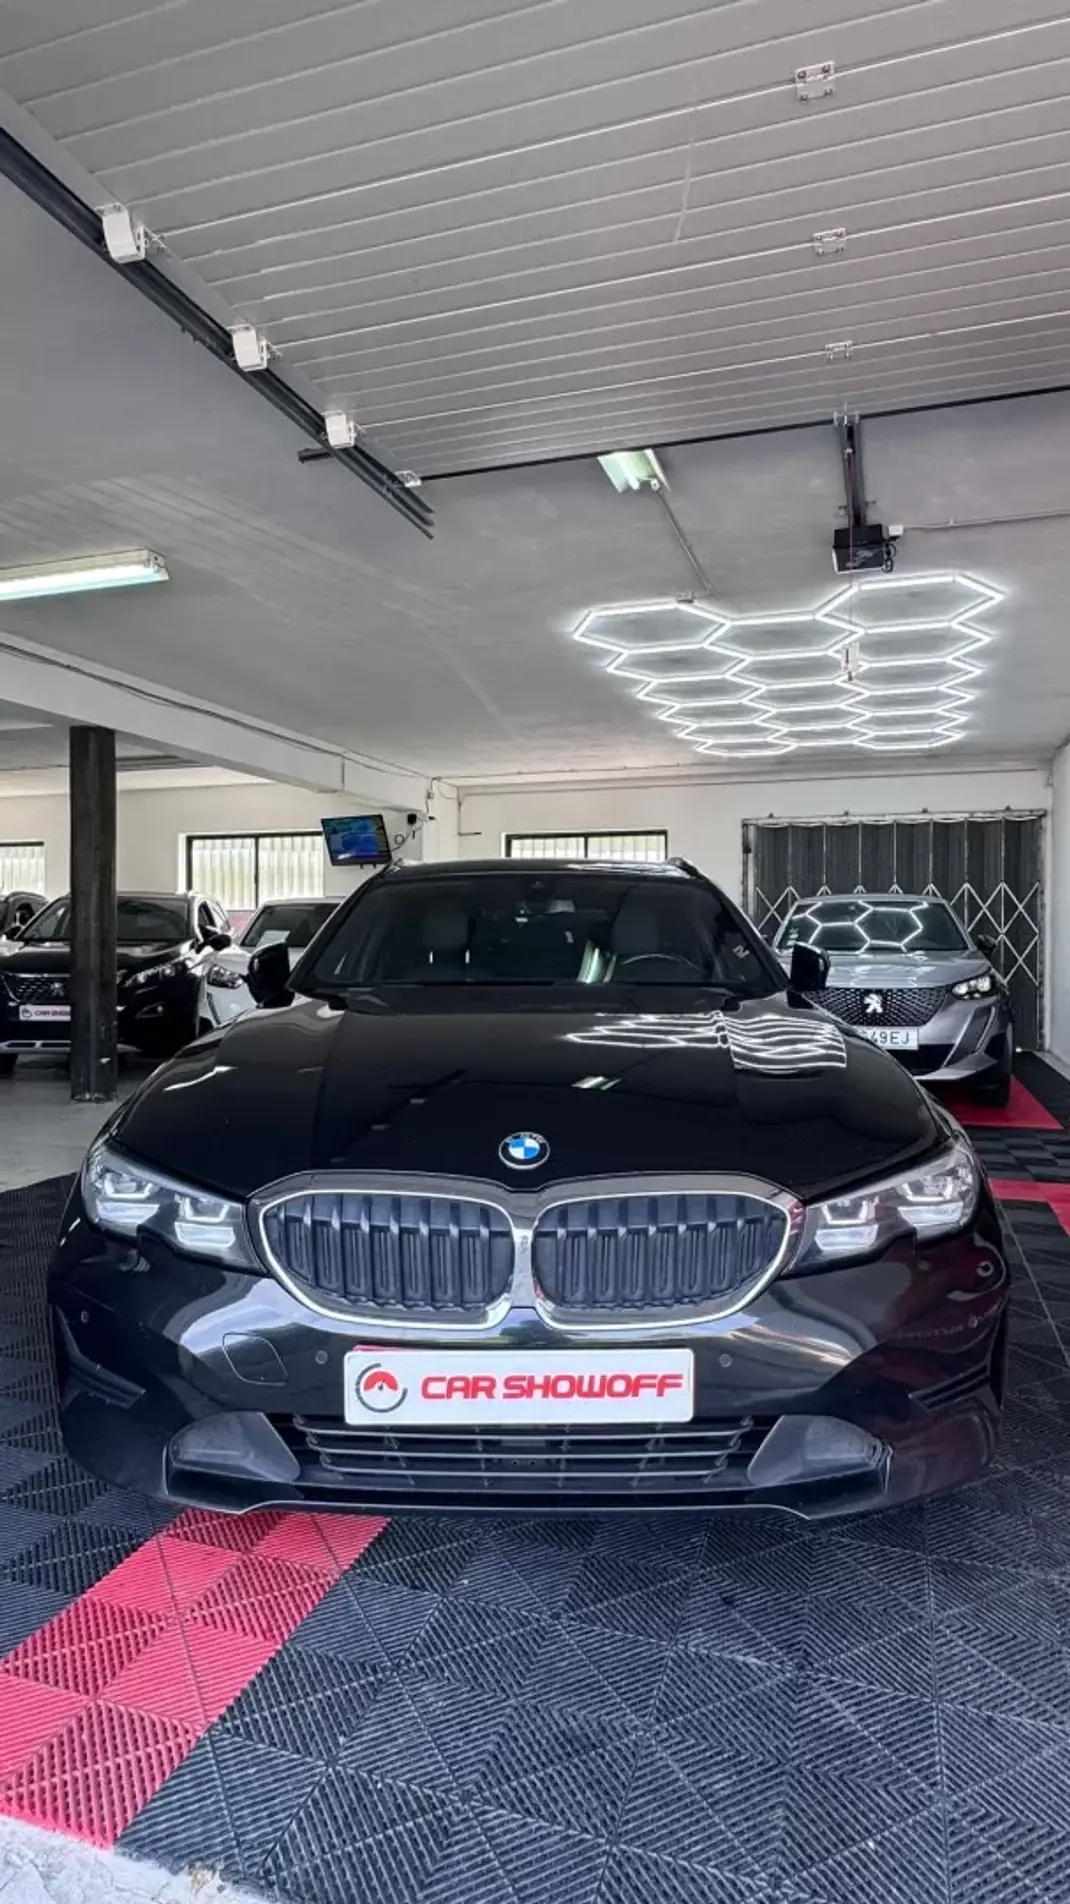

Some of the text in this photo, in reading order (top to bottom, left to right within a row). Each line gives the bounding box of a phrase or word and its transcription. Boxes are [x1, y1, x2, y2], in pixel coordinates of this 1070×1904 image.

[863, 1030, 909, 1045] 49EJ
[421, 1373, 684, 1400] CAR SHOWOFF
